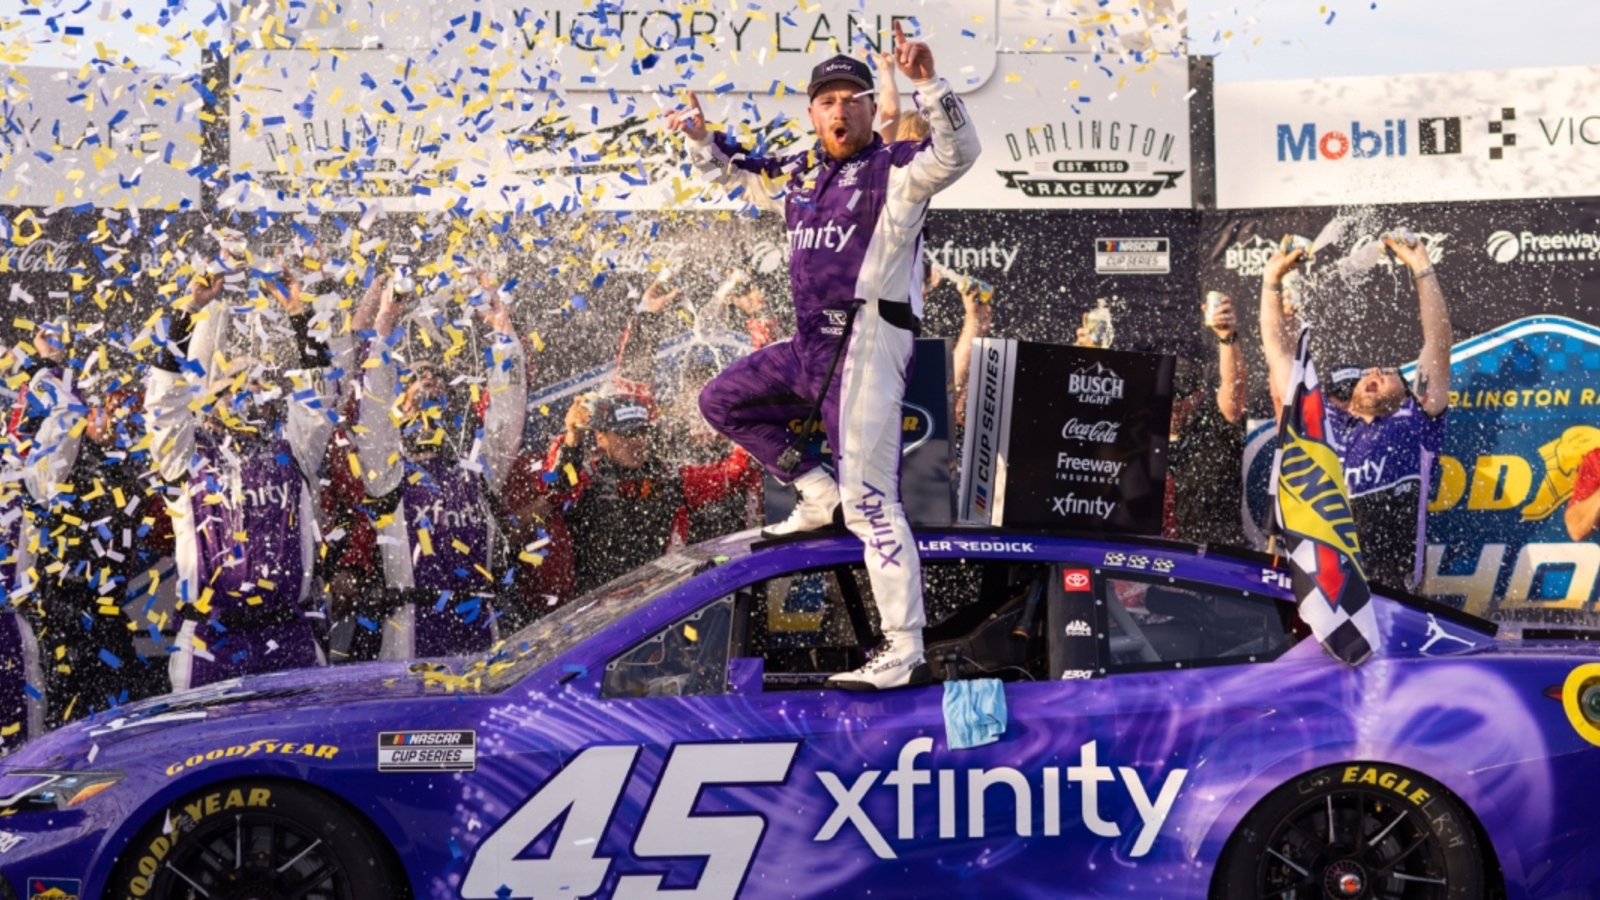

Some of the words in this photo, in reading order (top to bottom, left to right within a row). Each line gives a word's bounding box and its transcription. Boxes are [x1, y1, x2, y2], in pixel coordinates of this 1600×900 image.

[1005, 119, 1176, 163] DARLINGTON
[1276, 118, 1407, 162] Mobil
[1058, 162, 1087, 172] EST.
[1093, 162, 1124, 172] 1950
[1036, 182, 1148, 196] RACEWAY
[1120, 240, 1160, 252] NASCAR
[1520, 231, 1600, 252] Freeway
[924, 241, 1019, 271] xfinity
[1226, 248, 1277, 270] BUSC
[981, 346, 999, 432] SERIES
[1067, 373, 1125, 400] BUSCH
[1580, 387, 1600, 406] R
[1077, 394, 1112, 406] LIGHT
[977, 434, 994, 484] CUP
[1056, 452, 1122, 478] Freeway
[1055, 472, 1121, 486] INSURANCE
[1051, 492, 1116, 520] xfinity
[855, 481, 902, 570] xfinity
[953, 541, 1035, 553] REDDICK
[409, 733, 461, 745] NASCAR
[165, 738, 340, 778] GOODYEAR
[391, 751, 417, 763] CUP
[419, 749, 462, 762] SERIES
[813, 737, 1190, 859] xfinity
[1341, 766, 1431, 806] EAGLE
[461, 743, 799, 900] 45
